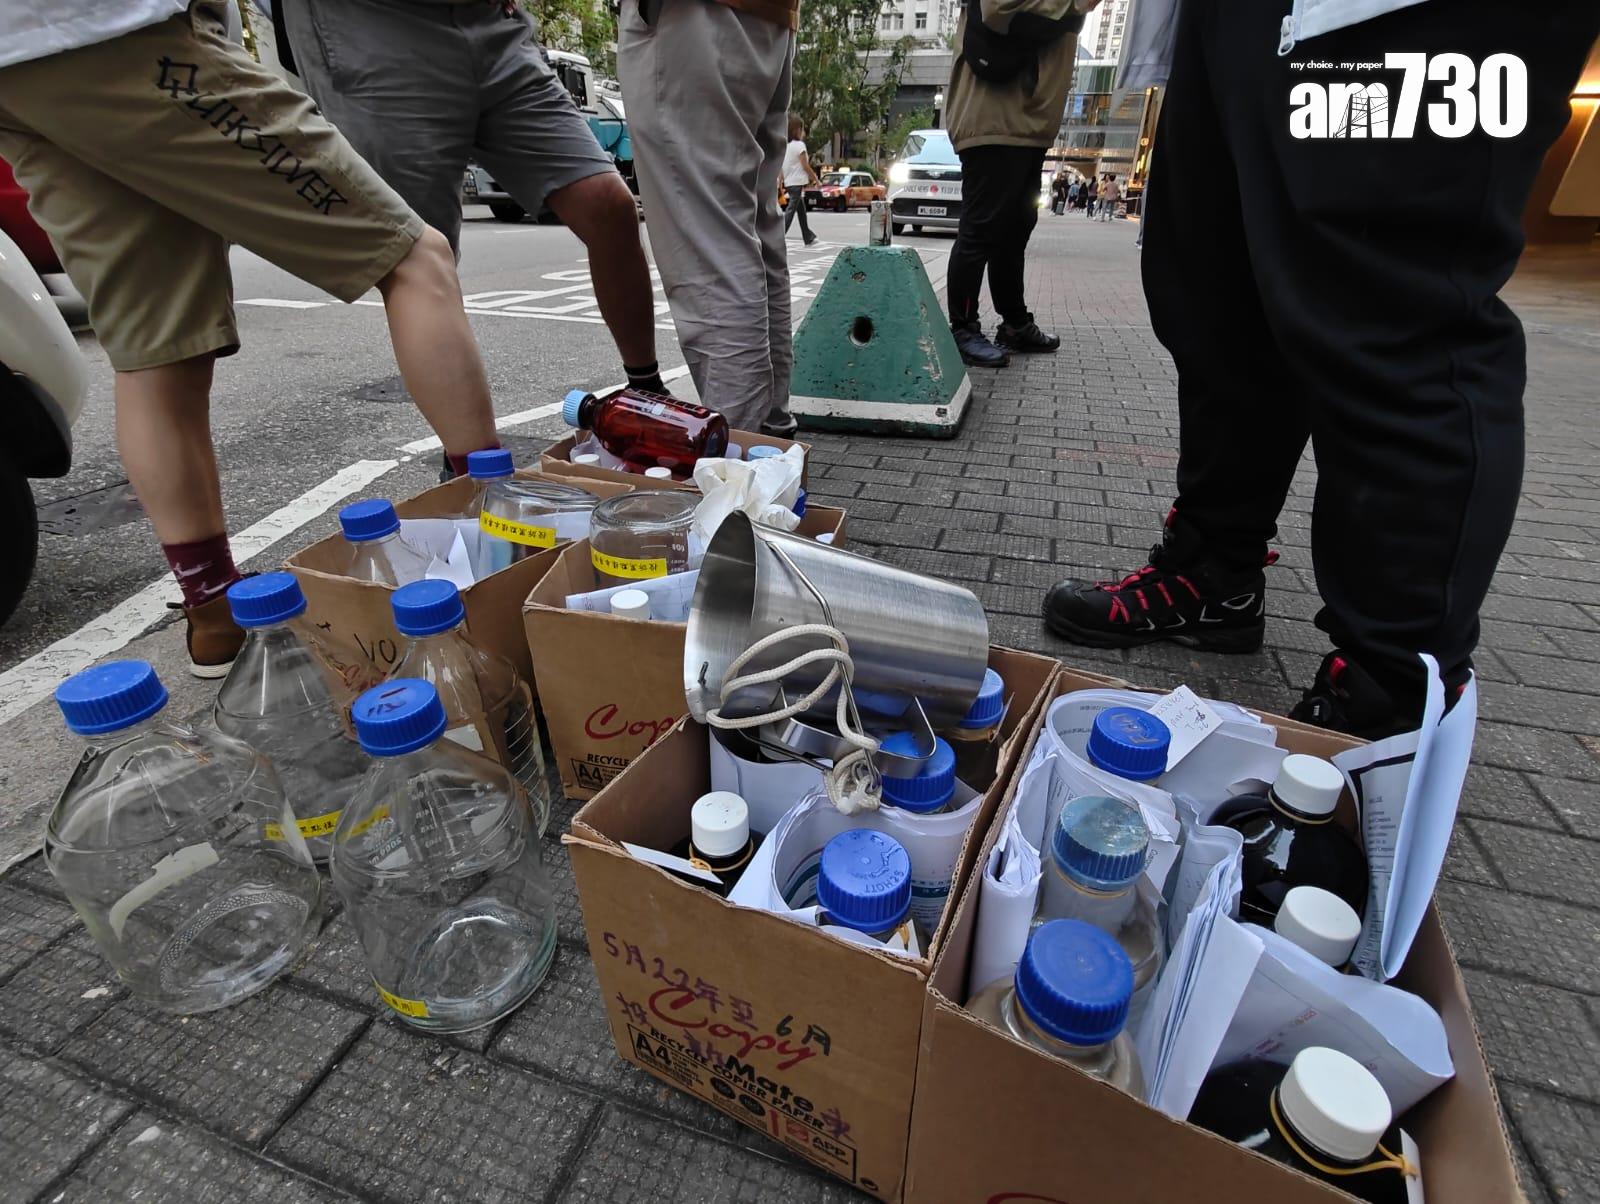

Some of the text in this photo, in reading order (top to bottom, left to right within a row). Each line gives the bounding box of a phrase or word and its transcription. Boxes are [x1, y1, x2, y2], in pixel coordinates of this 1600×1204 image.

[584, 703, 676, 747] Cop
[578, 764, 604, 784] A4
[863, 869, 905, 894] SCHOTT
[635, 1032, 672, 1066] A4
[648, 987, 817, 1071] Copy
[713, 1063, 768, 1100] COPIER
[771, 1096, 826, 1131] PAPER
[725, 1054, 815, 1113] Mate
